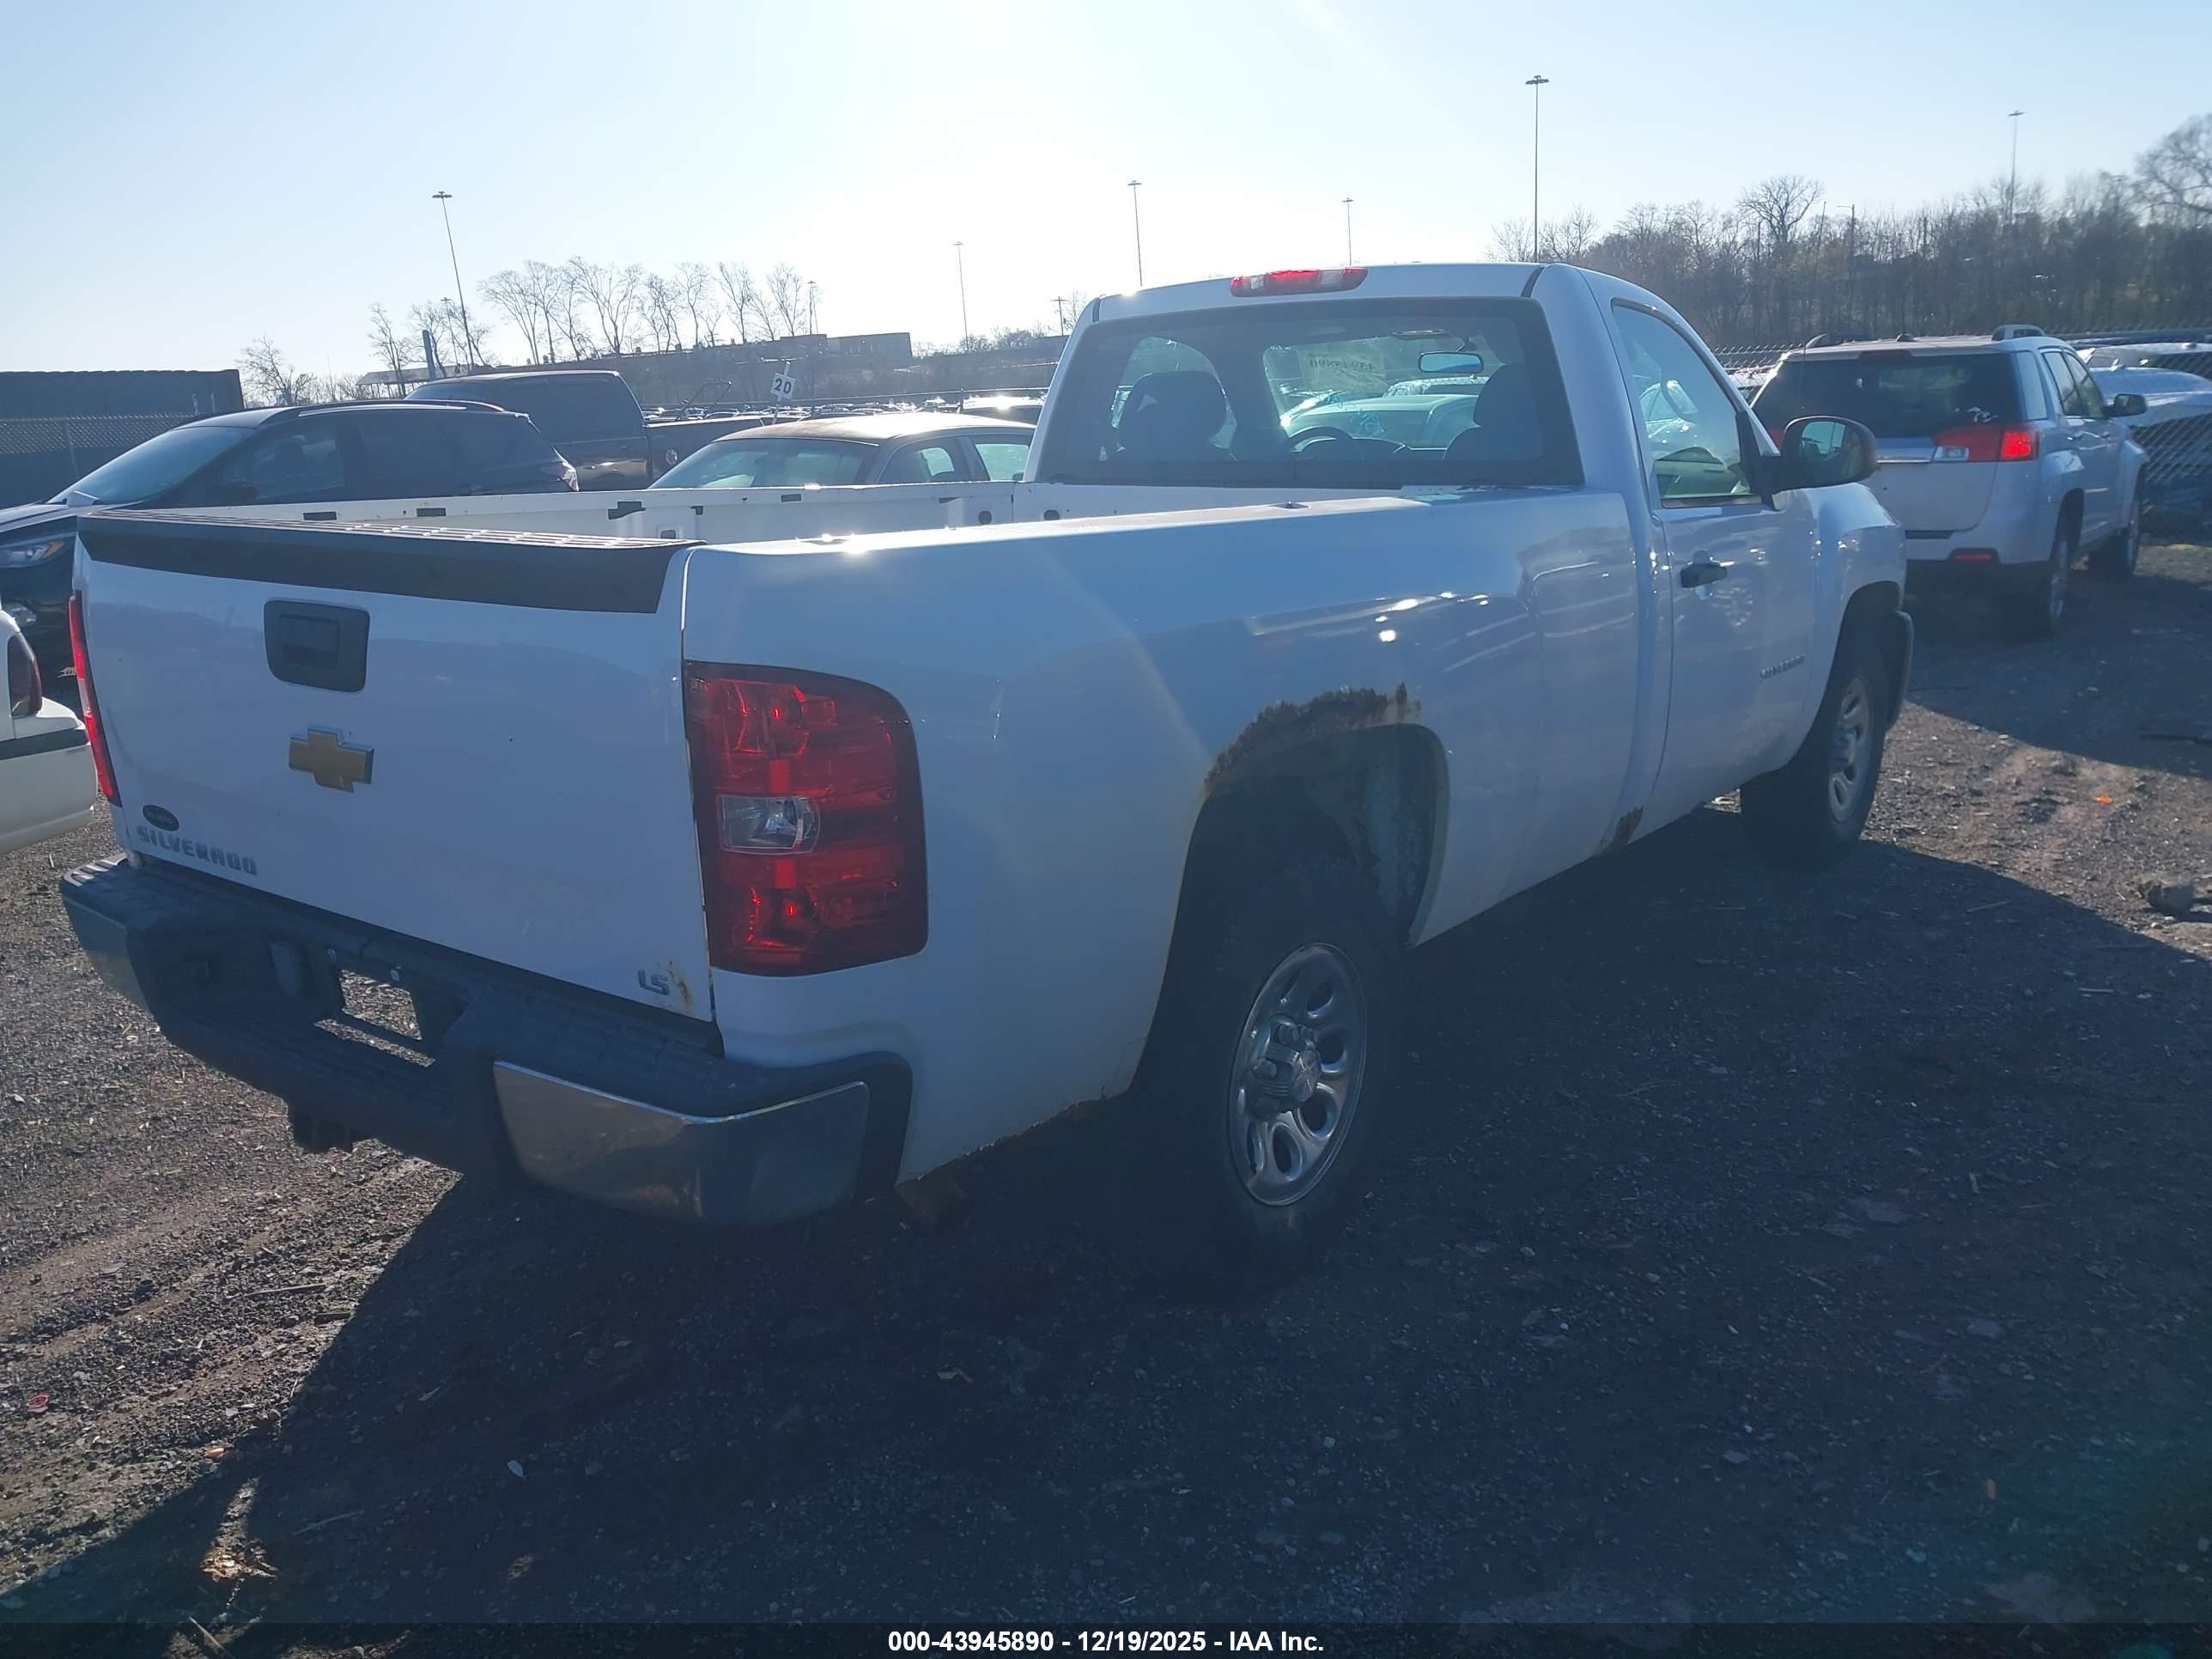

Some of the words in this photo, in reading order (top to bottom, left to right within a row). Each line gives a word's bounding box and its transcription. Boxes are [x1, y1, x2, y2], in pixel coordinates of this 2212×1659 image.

[775, 378, 792, 394] 20
[137, 824, 258, 875] SILVERADO
[638, 969, 669, 995] LS
